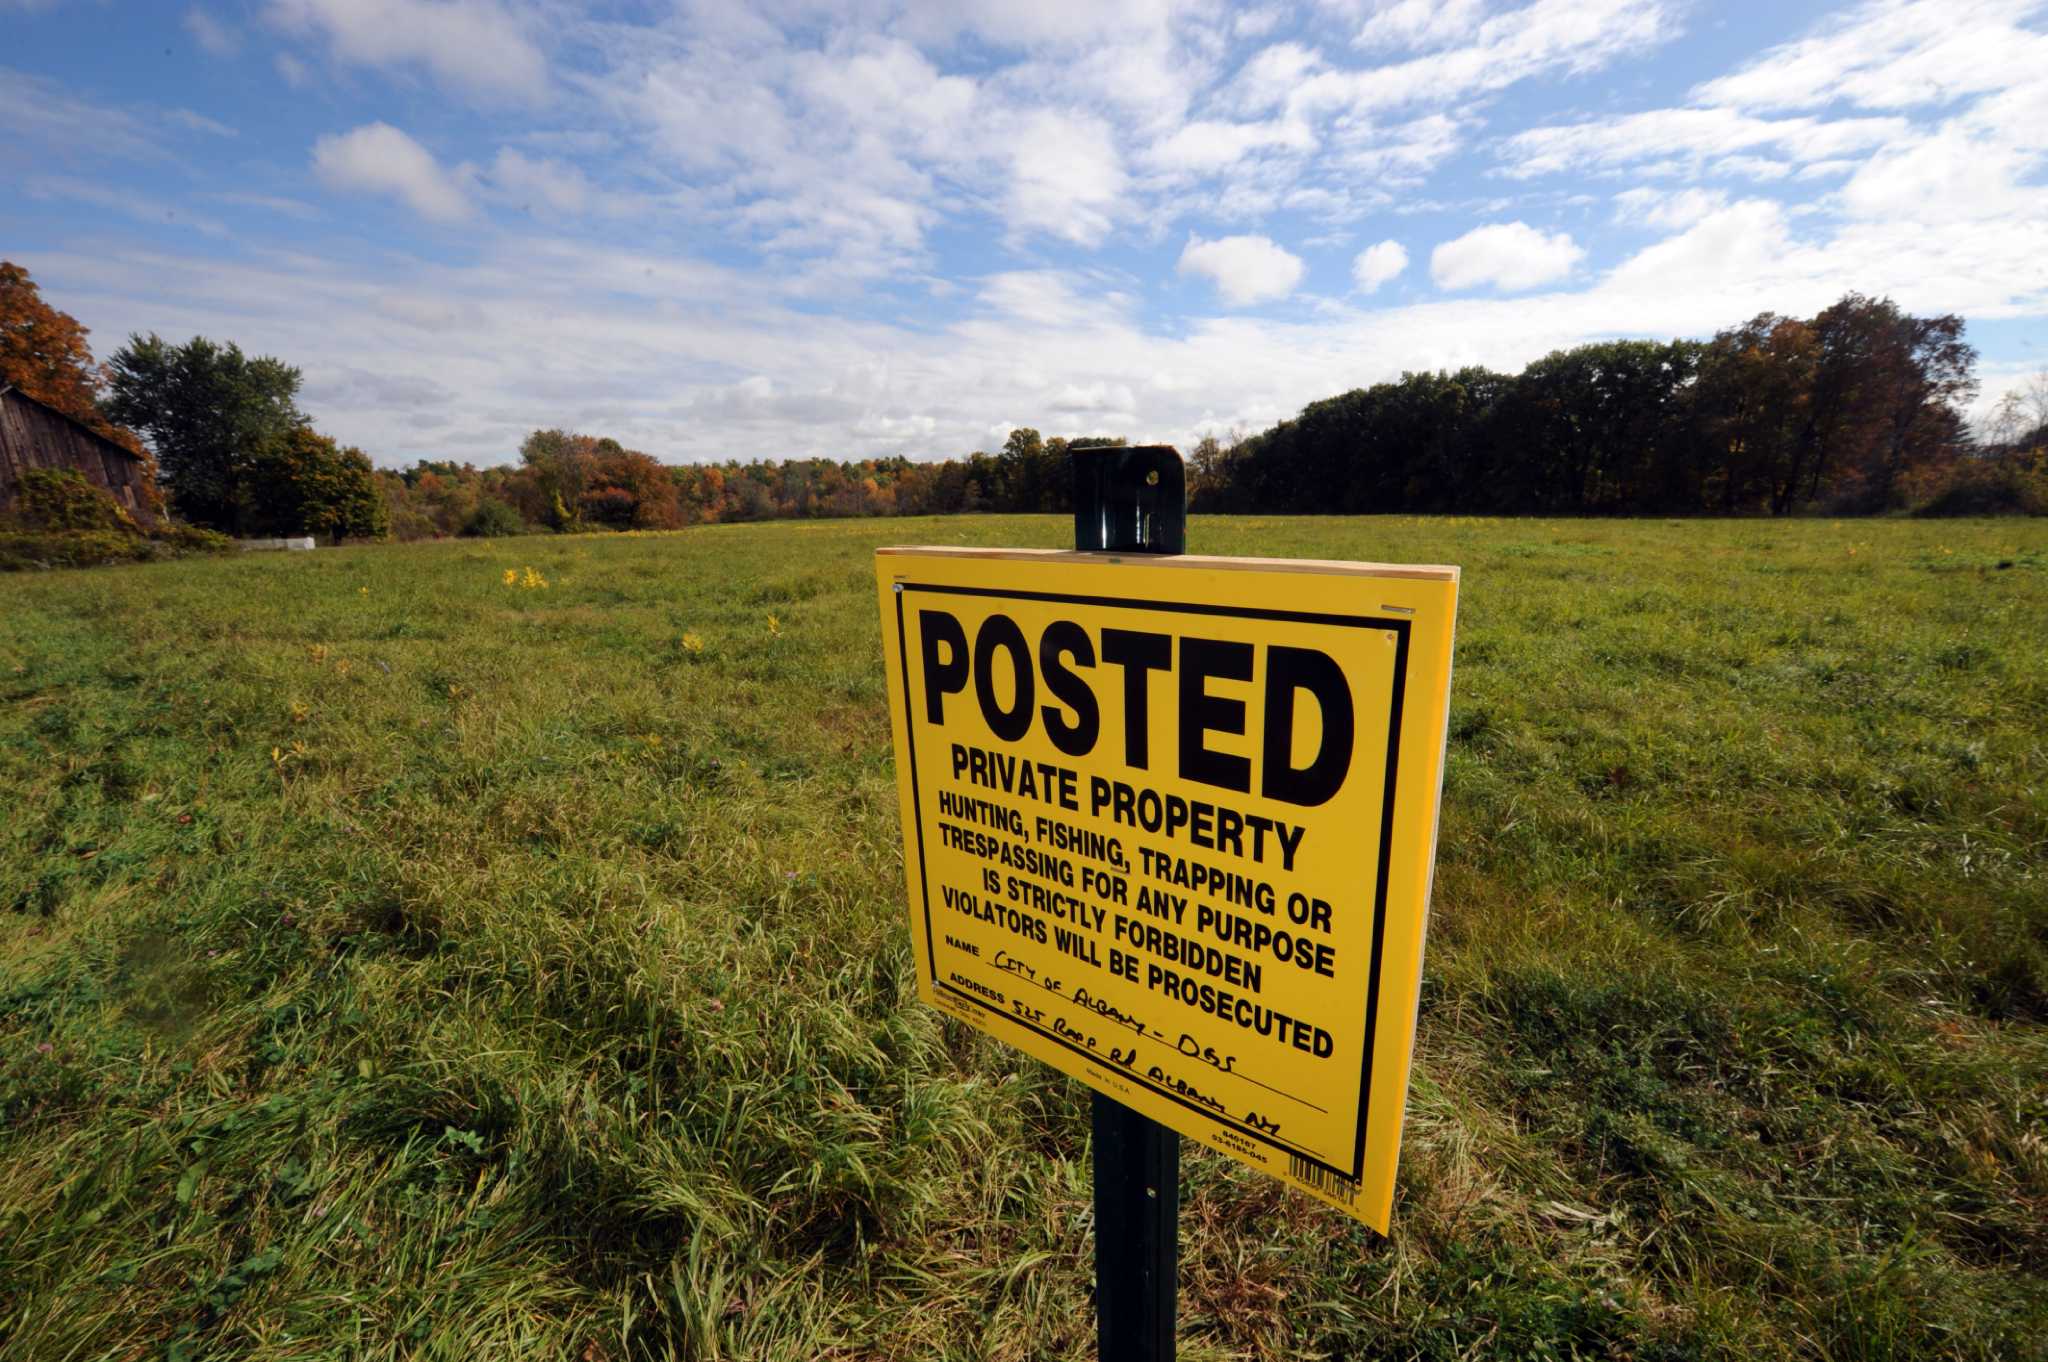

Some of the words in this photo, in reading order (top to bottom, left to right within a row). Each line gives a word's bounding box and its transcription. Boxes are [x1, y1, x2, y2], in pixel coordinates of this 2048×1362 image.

[919, 609, 1355, 807] POSTED
[939, 790, 1029, 843] HUNTING,
[1036, 816, 1130, 873] FISHING,
[1138, 847, 1275, 915] TRAPPING
[1288, 892, 1332, 934] OR
[952, 743, 1079, 811] PRIVATE
[1091, 776, 1305, 872] PROPERTY
[938, 822, 1074, 887] TRESPASSING
[1082, 867, 1127, 905] FOR
[1136, 886, 1188, 925] ANY
[1197, 904, 1335, 978] PURPOSE
[945, 935, 980, 956] NAME
[983, 868, 1001, 894] IS
[1007, 876, 1106, 933] STRICTLY
[1115, 914, 1261, 993] FORBIDDEN
[942, 885, 1047, 944] VIOLATORS
[1054, 926, 1101, 968] WILL
[1110, 948, 1139, 983] BE
[1149, 963, 1333, 1059] PROSECUTED
[950, 972, 1005, 1004] ADDRESS
